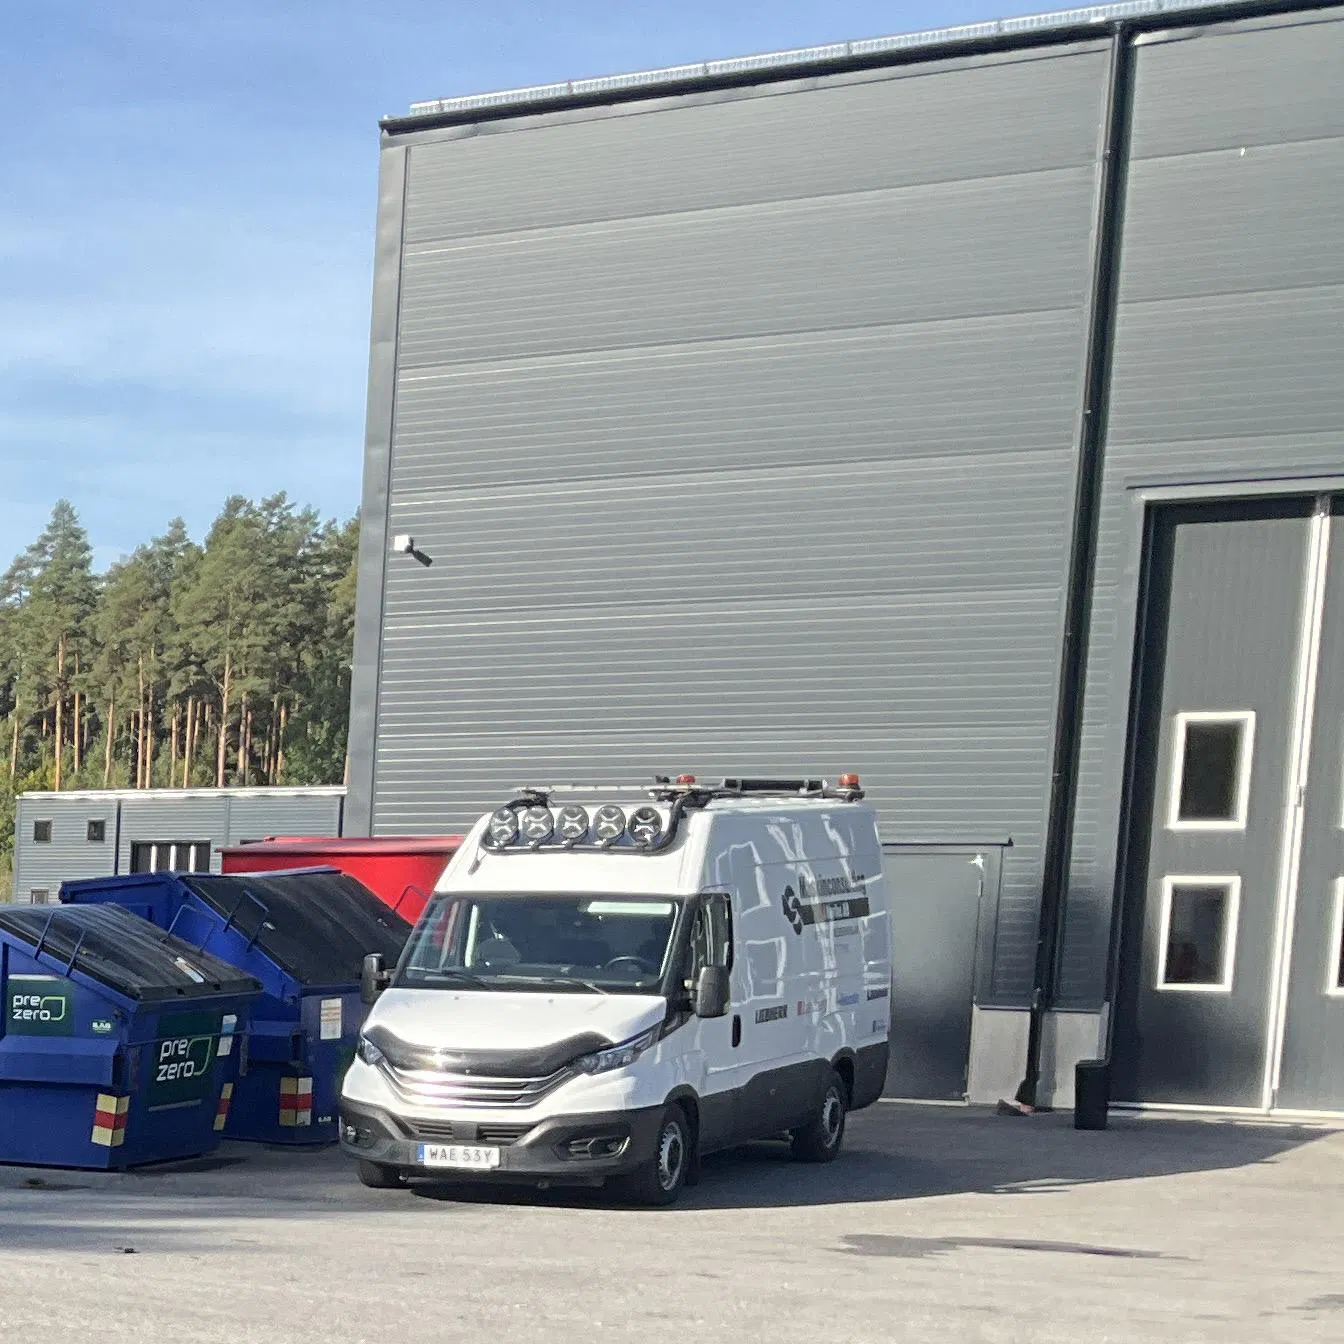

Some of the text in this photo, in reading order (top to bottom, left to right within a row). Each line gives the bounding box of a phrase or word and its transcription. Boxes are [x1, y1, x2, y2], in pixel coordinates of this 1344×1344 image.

[13, 994, 41, 1007] pre
[13, 1008, 51, 1021] zero
[160, 1038, 188, 1062] pre
[156, 1061, 194, 1082] zero
[430, 1148, 493, 1163] WAE 53Y
